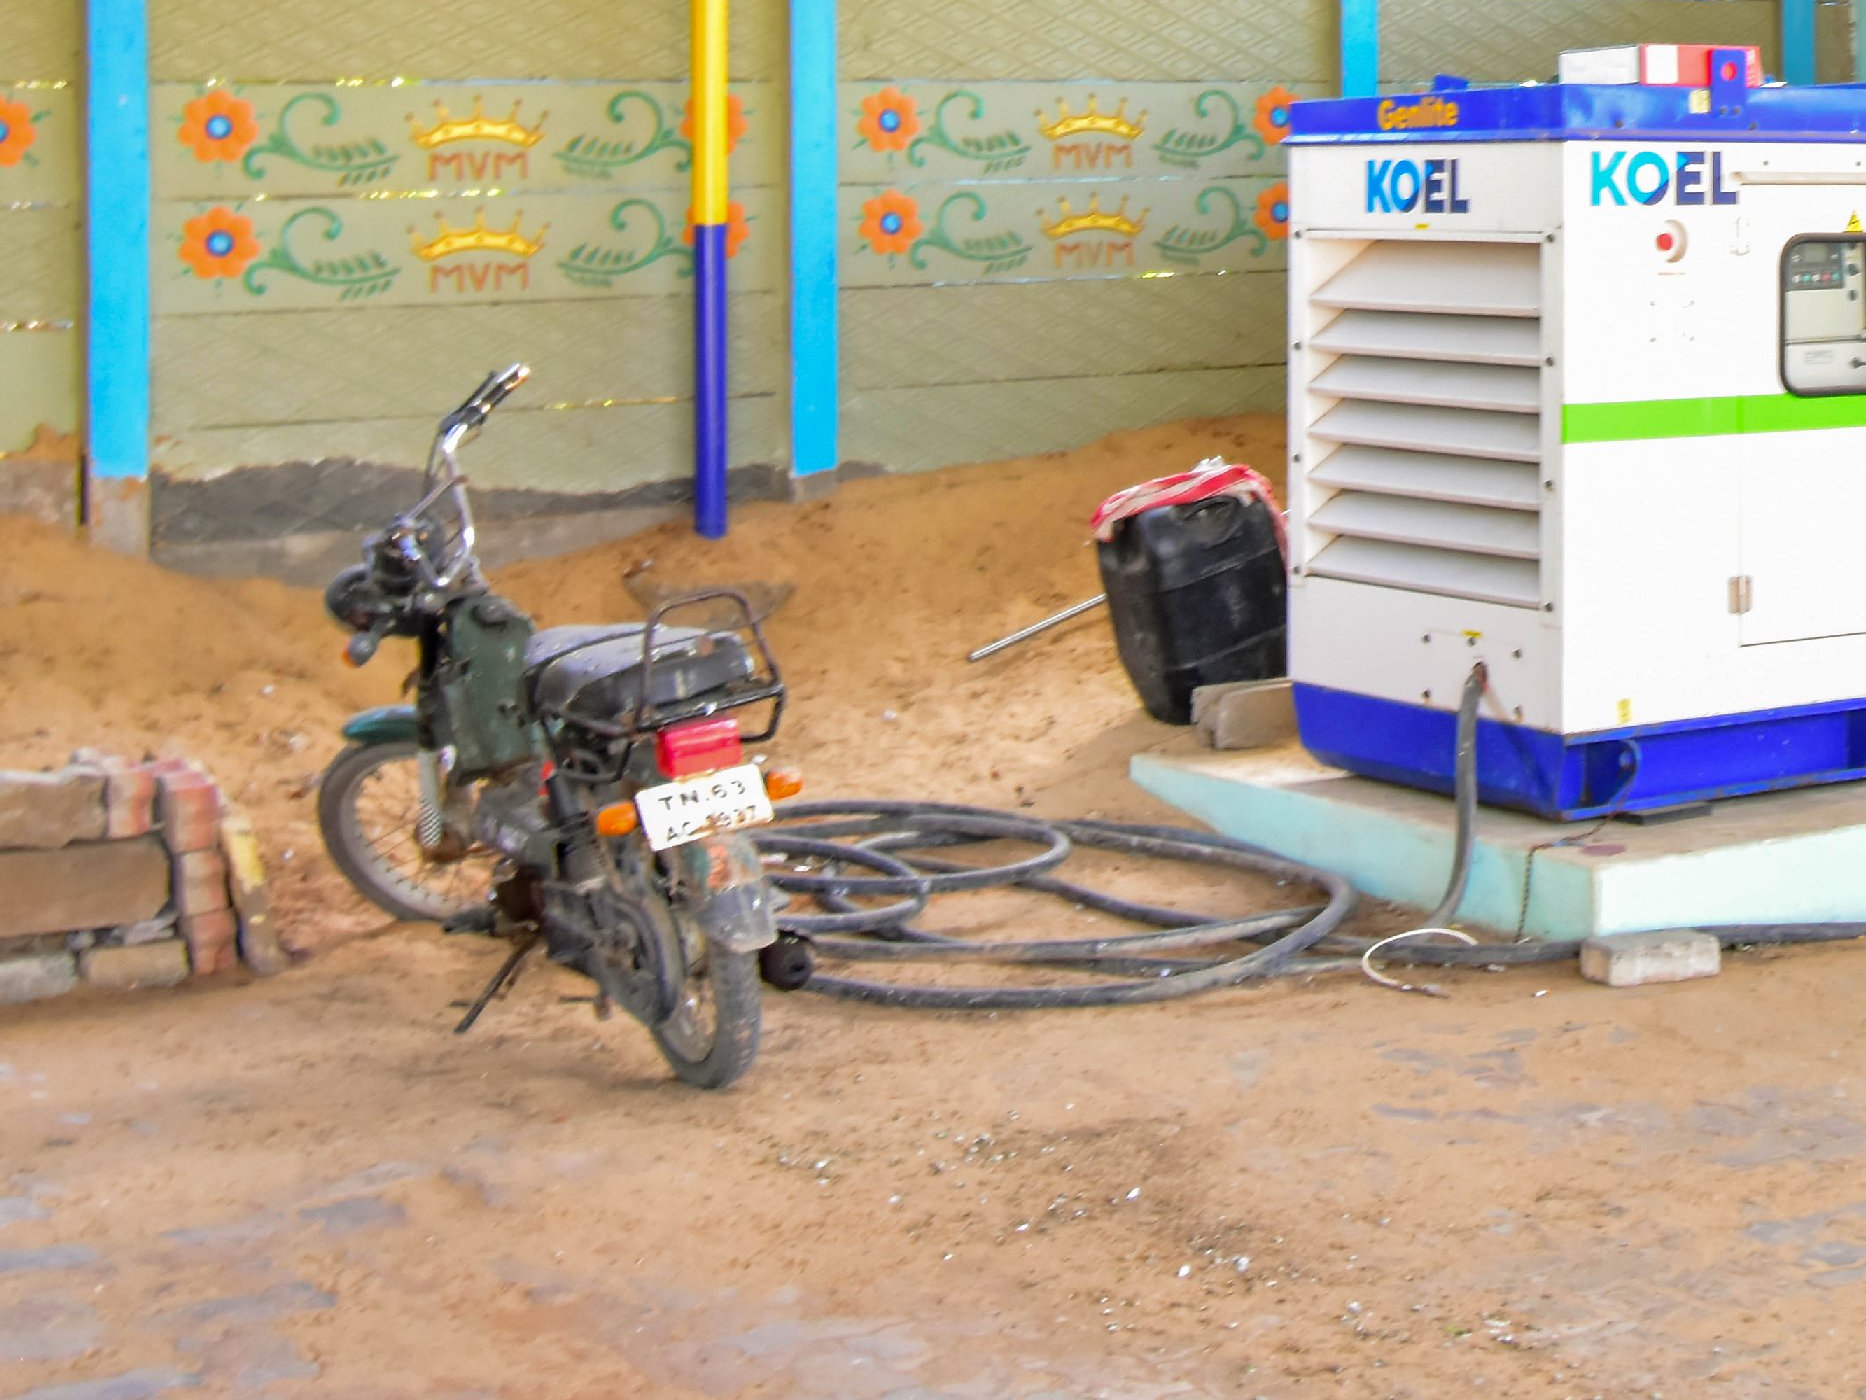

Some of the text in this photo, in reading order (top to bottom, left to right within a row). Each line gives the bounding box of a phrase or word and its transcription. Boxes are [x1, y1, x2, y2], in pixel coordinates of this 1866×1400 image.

[1378, 97, 1459, 130] Genlite
[429, 152, 528, 181] MVM
[1053, 143, 1133, 168] MVM
[1366, 159, 1469, 213] KOEL
[1591, 151, 1738, 206] KOEL
[1055, 241, 1134, 268] MVM
[430, 262, 529, 293] MVM
